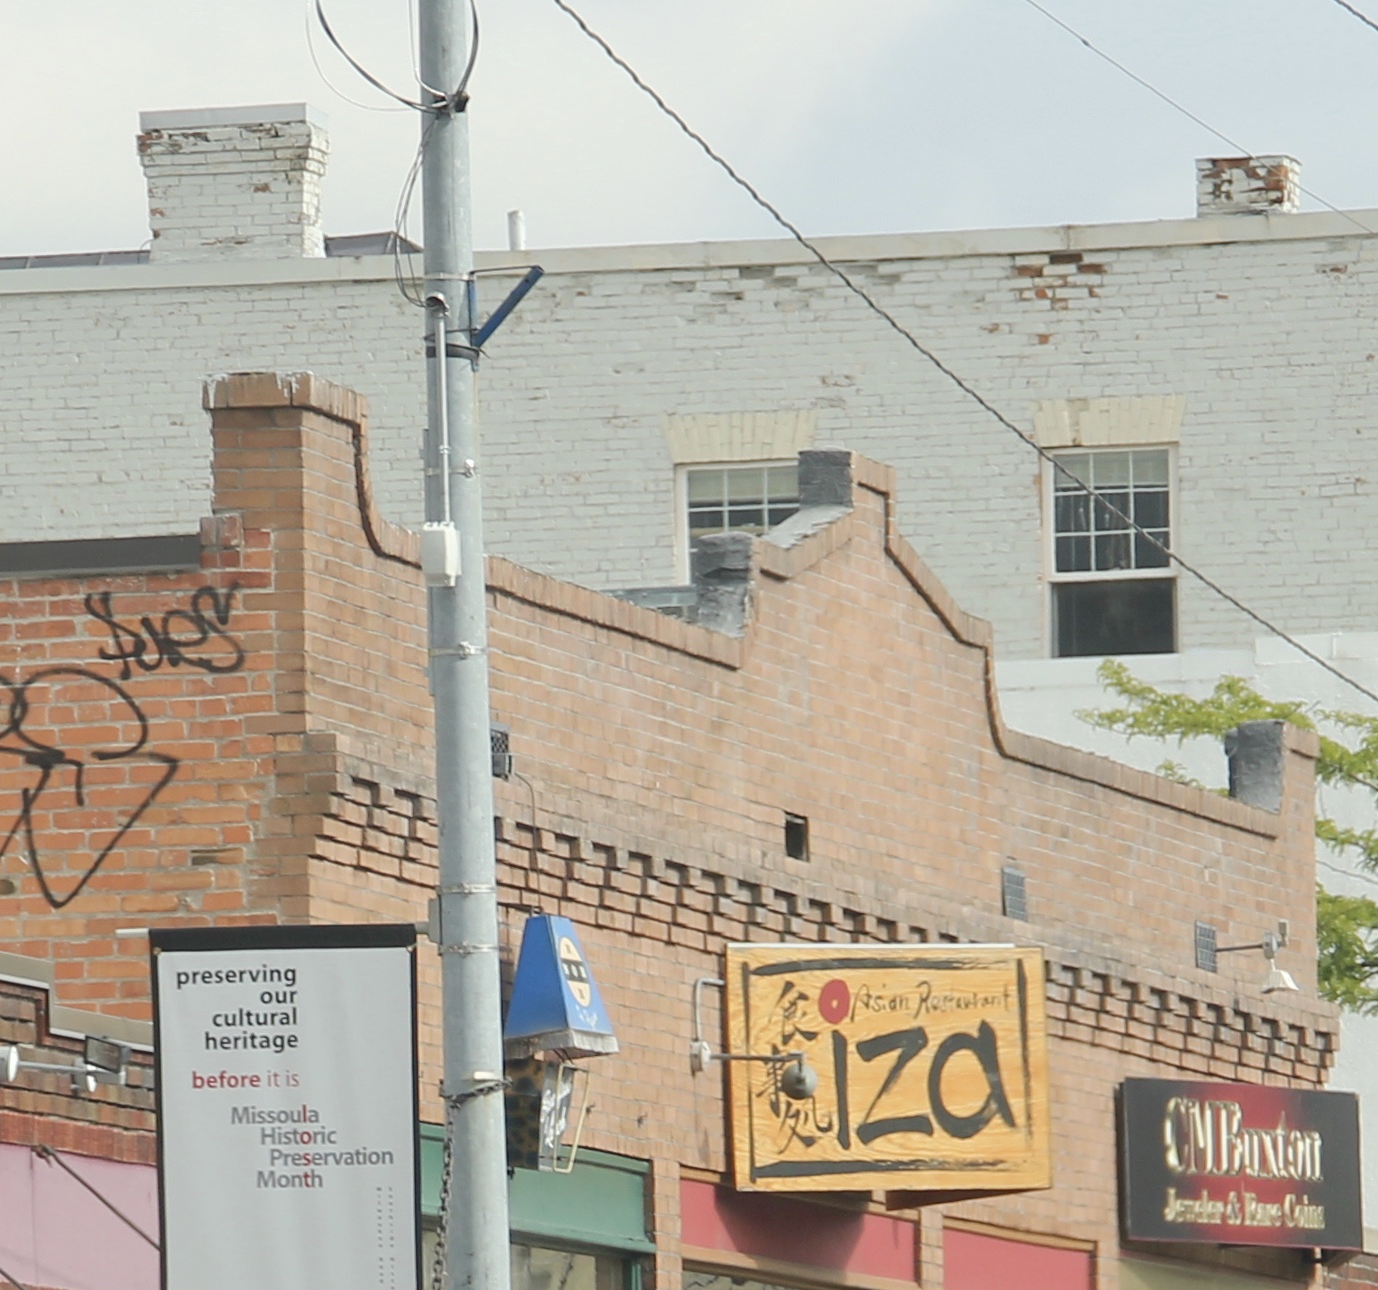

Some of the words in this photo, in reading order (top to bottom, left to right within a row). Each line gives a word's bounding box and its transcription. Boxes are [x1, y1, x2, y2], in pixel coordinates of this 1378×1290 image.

[176, 964, 298, 989] preserving
[259, 988, 298, 1006] our
[850, 983, 910, 1023] Asian
[912, 980, 1011, 1020] Restaurant
[212, 1007, 298, 1028] cultural
[204, 1030, 299, 1053] heritage
[191, 1070, 261, 1090] before
[266, 1070, 281, 1089] it
[285, 1069, 300, 1088] is
[231, 1104, 320, 1126] Missoula
[259, 1126, 337, 1147] Historic
[269, 1146, 394, 1168] Preservation
[256, 1168, 324, 1190] Month
[1226, 1190, 1242, 1226] &
[1243, 1191, 1283, 1227] Rare
[1284, 1194, 1326, 1230] Coins
